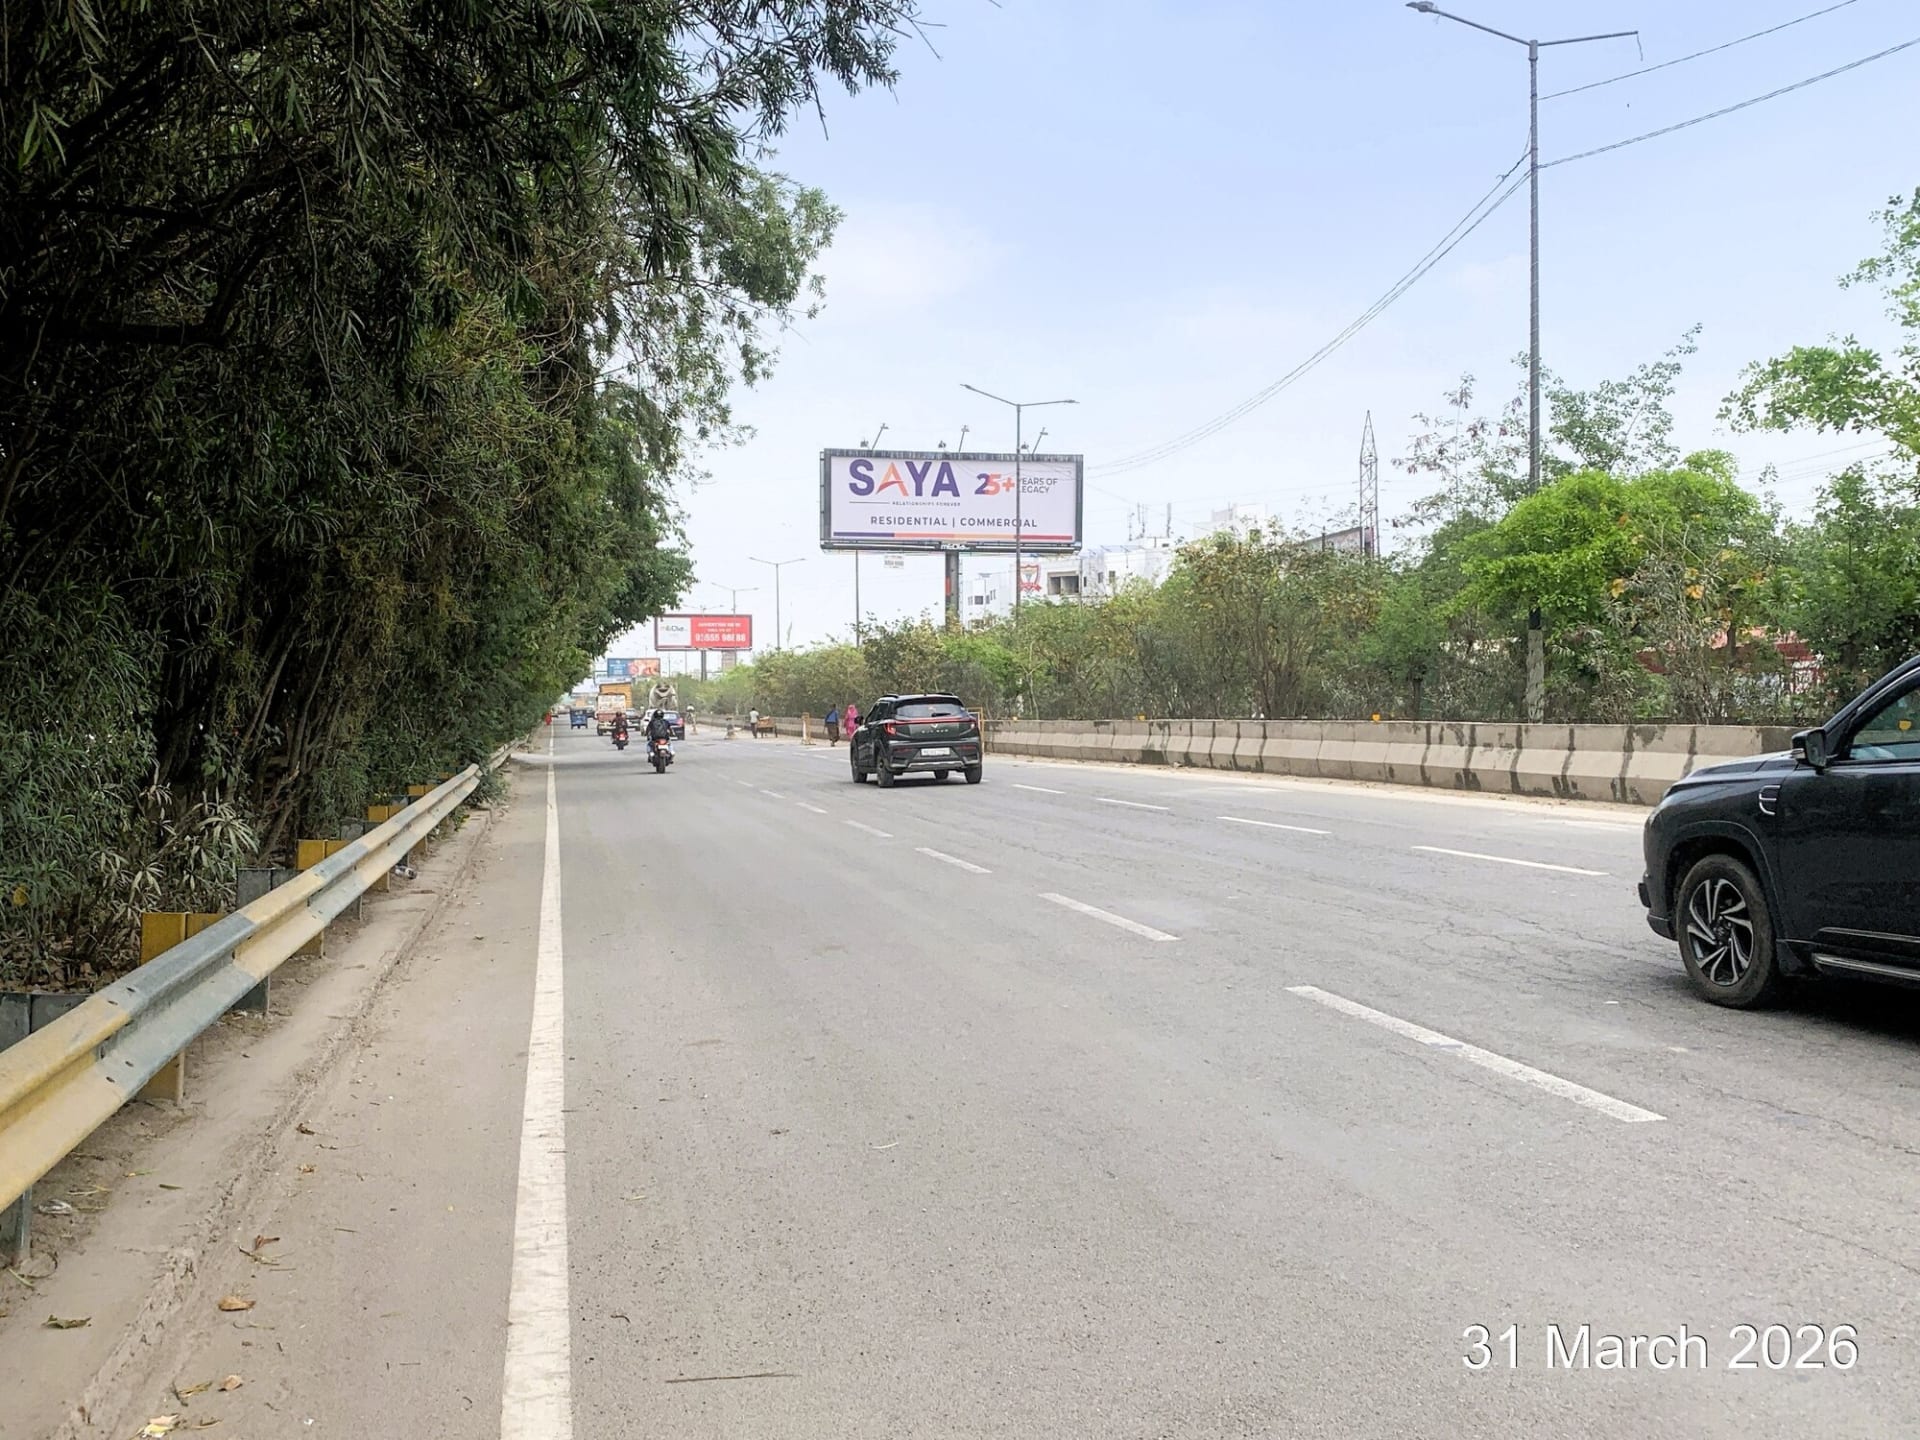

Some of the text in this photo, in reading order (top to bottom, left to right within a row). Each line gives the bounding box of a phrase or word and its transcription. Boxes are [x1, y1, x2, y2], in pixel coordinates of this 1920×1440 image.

[849, 458, 961, 497] SAYA
[974, 472, 1015, 496] 25+
[1046, 478, 1059, 486] OF
[870, 516, 948, 526] RESIDENTIAL
